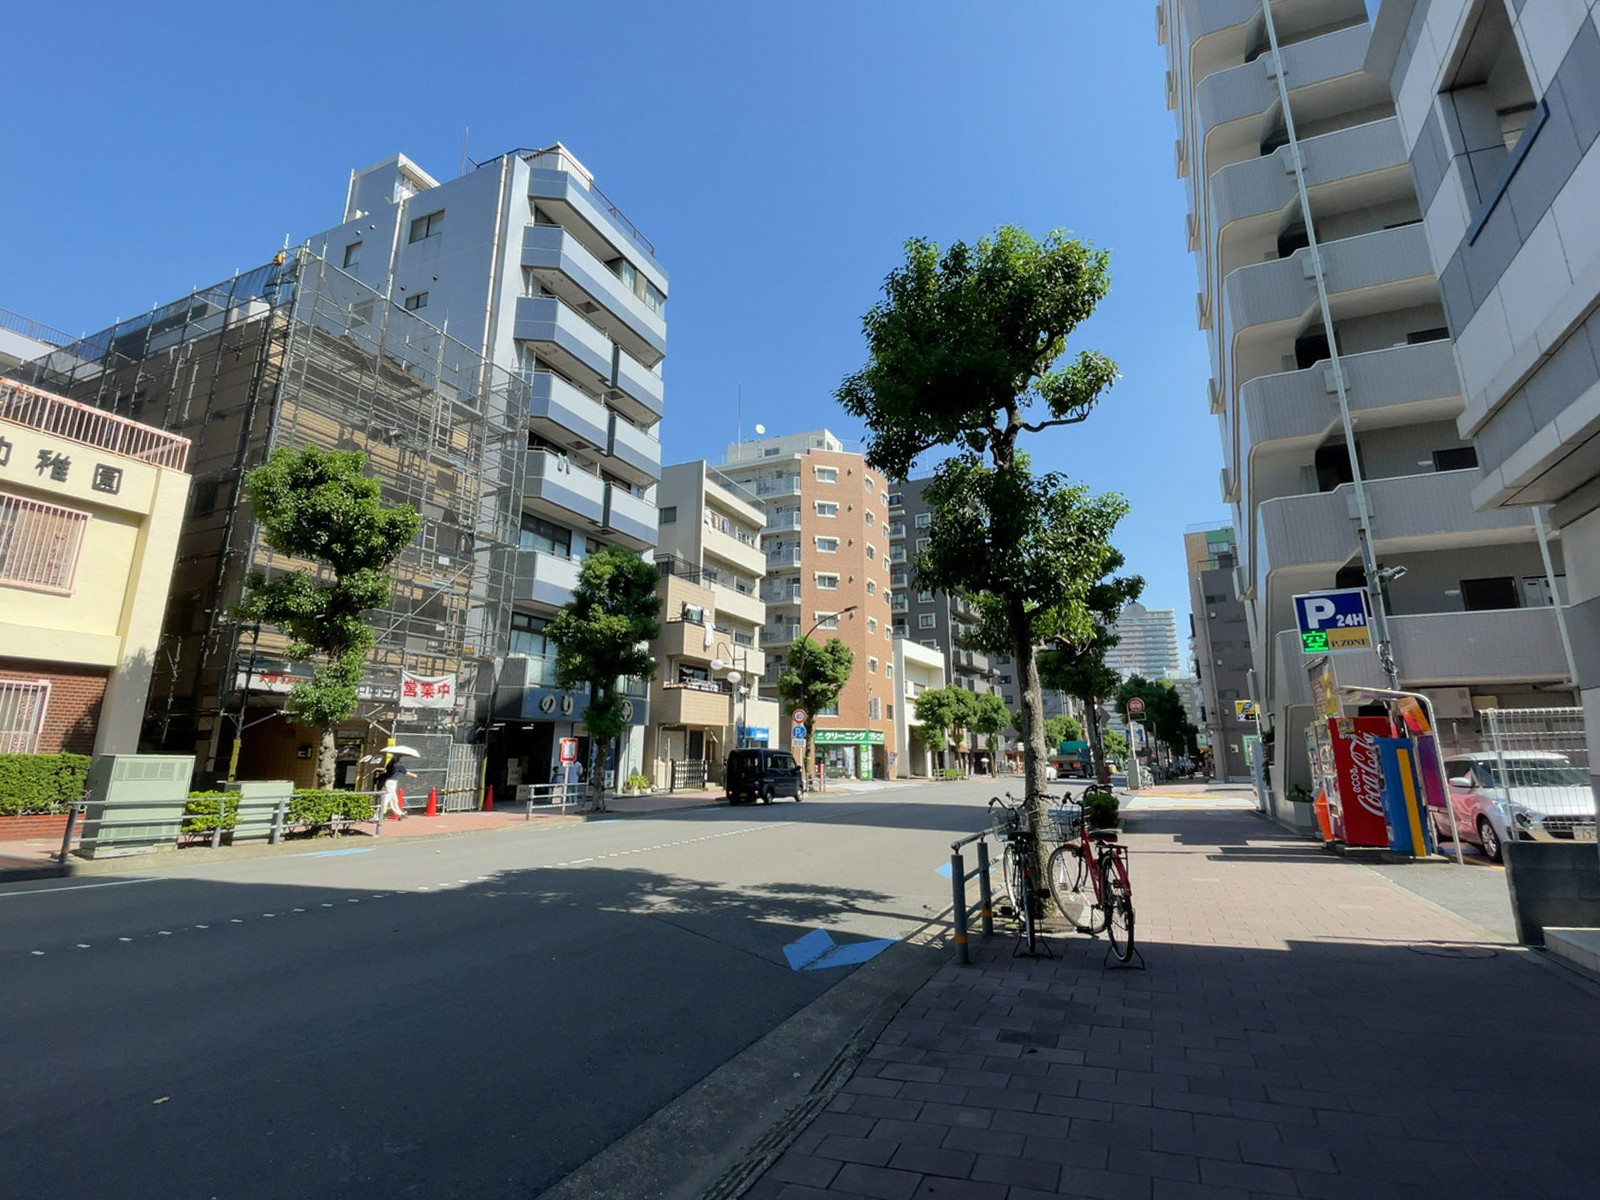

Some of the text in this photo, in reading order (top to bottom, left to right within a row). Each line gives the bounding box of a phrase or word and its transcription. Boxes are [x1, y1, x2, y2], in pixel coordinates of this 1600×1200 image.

[0, 436, 124, 495] 稚園
[1304, 598, 1335, 629] P
[1336, 613, 1365, 628] 24H
[1302, 630, 1330, 652] 空
[403, 680, 451, 700] 営業中
[540, 694, 574, 716] のり
[825, 732, 866, 741] クリーニング
[1350, 732, 1385, 817] Coca-Cola
